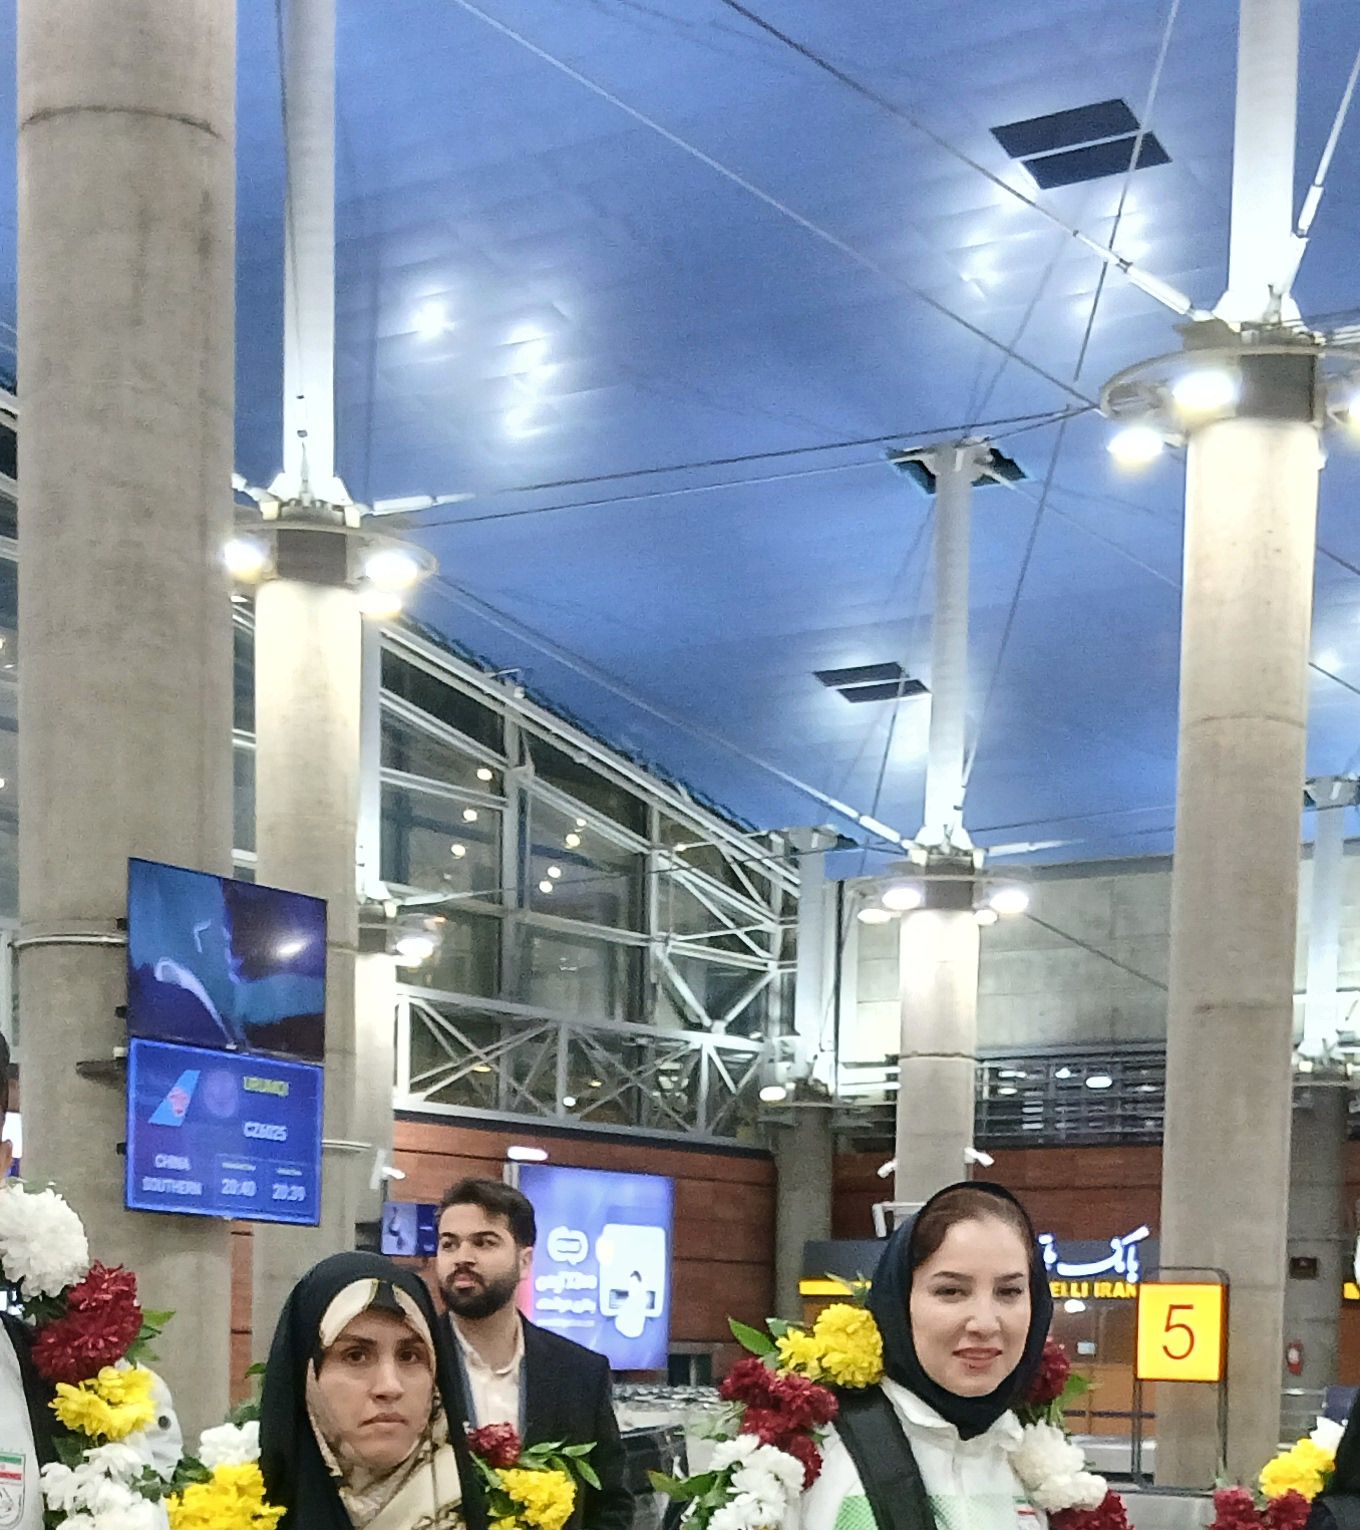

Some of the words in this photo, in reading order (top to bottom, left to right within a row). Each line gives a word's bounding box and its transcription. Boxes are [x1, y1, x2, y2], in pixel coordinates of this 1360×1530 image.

[1049, 1281, 1089, 1298] ELLI
[1094, 1281, 1137, 1298] IRAN
[1162, 1304, 1194, 1360] 5
